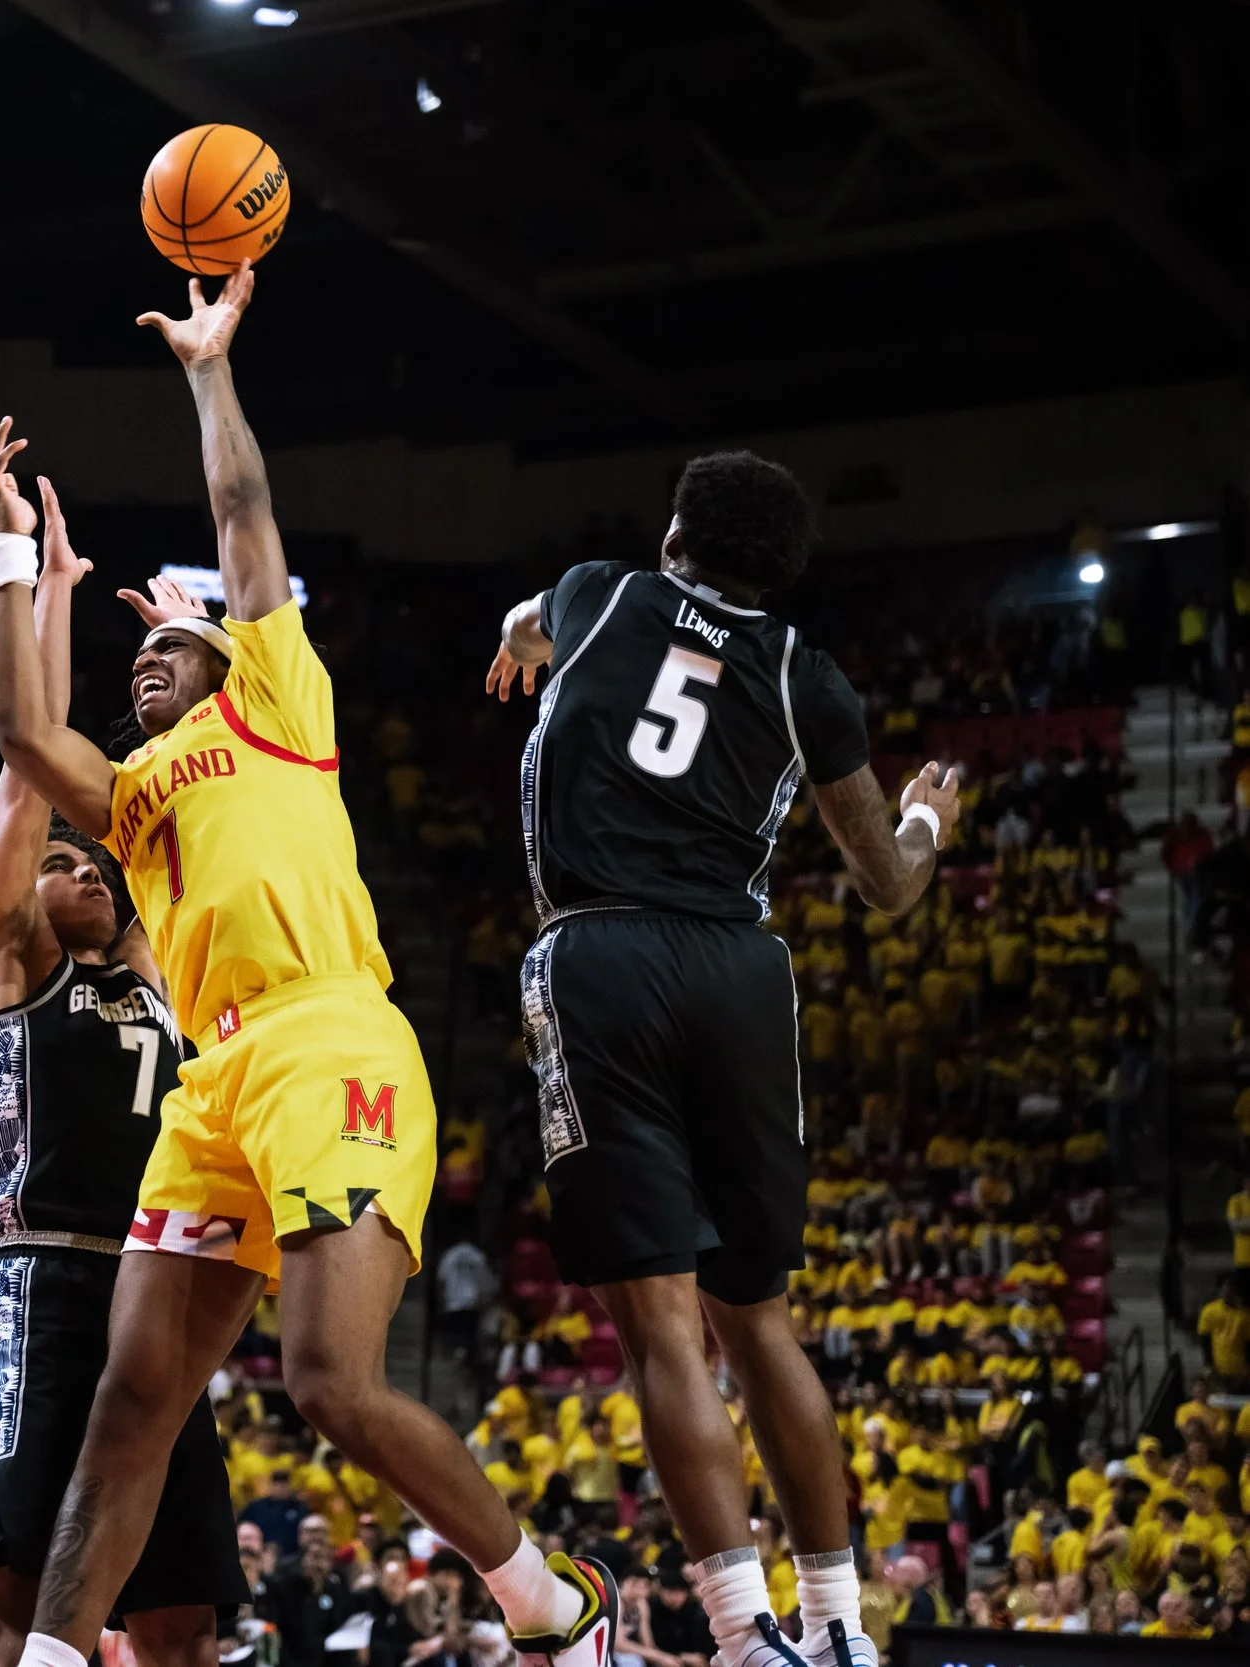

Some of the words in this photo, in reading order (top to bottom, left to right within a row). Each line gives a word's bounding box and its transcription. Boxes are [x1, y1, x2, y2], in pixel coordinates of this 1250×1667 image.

[233, 164, 286, 219] Wilso
[675, 599, 731, 649] LEWIS
[627, 642, 725, 778] 5
[117, 1024, 160, 1118] 7
[341, 1078, 398, 1142] M
